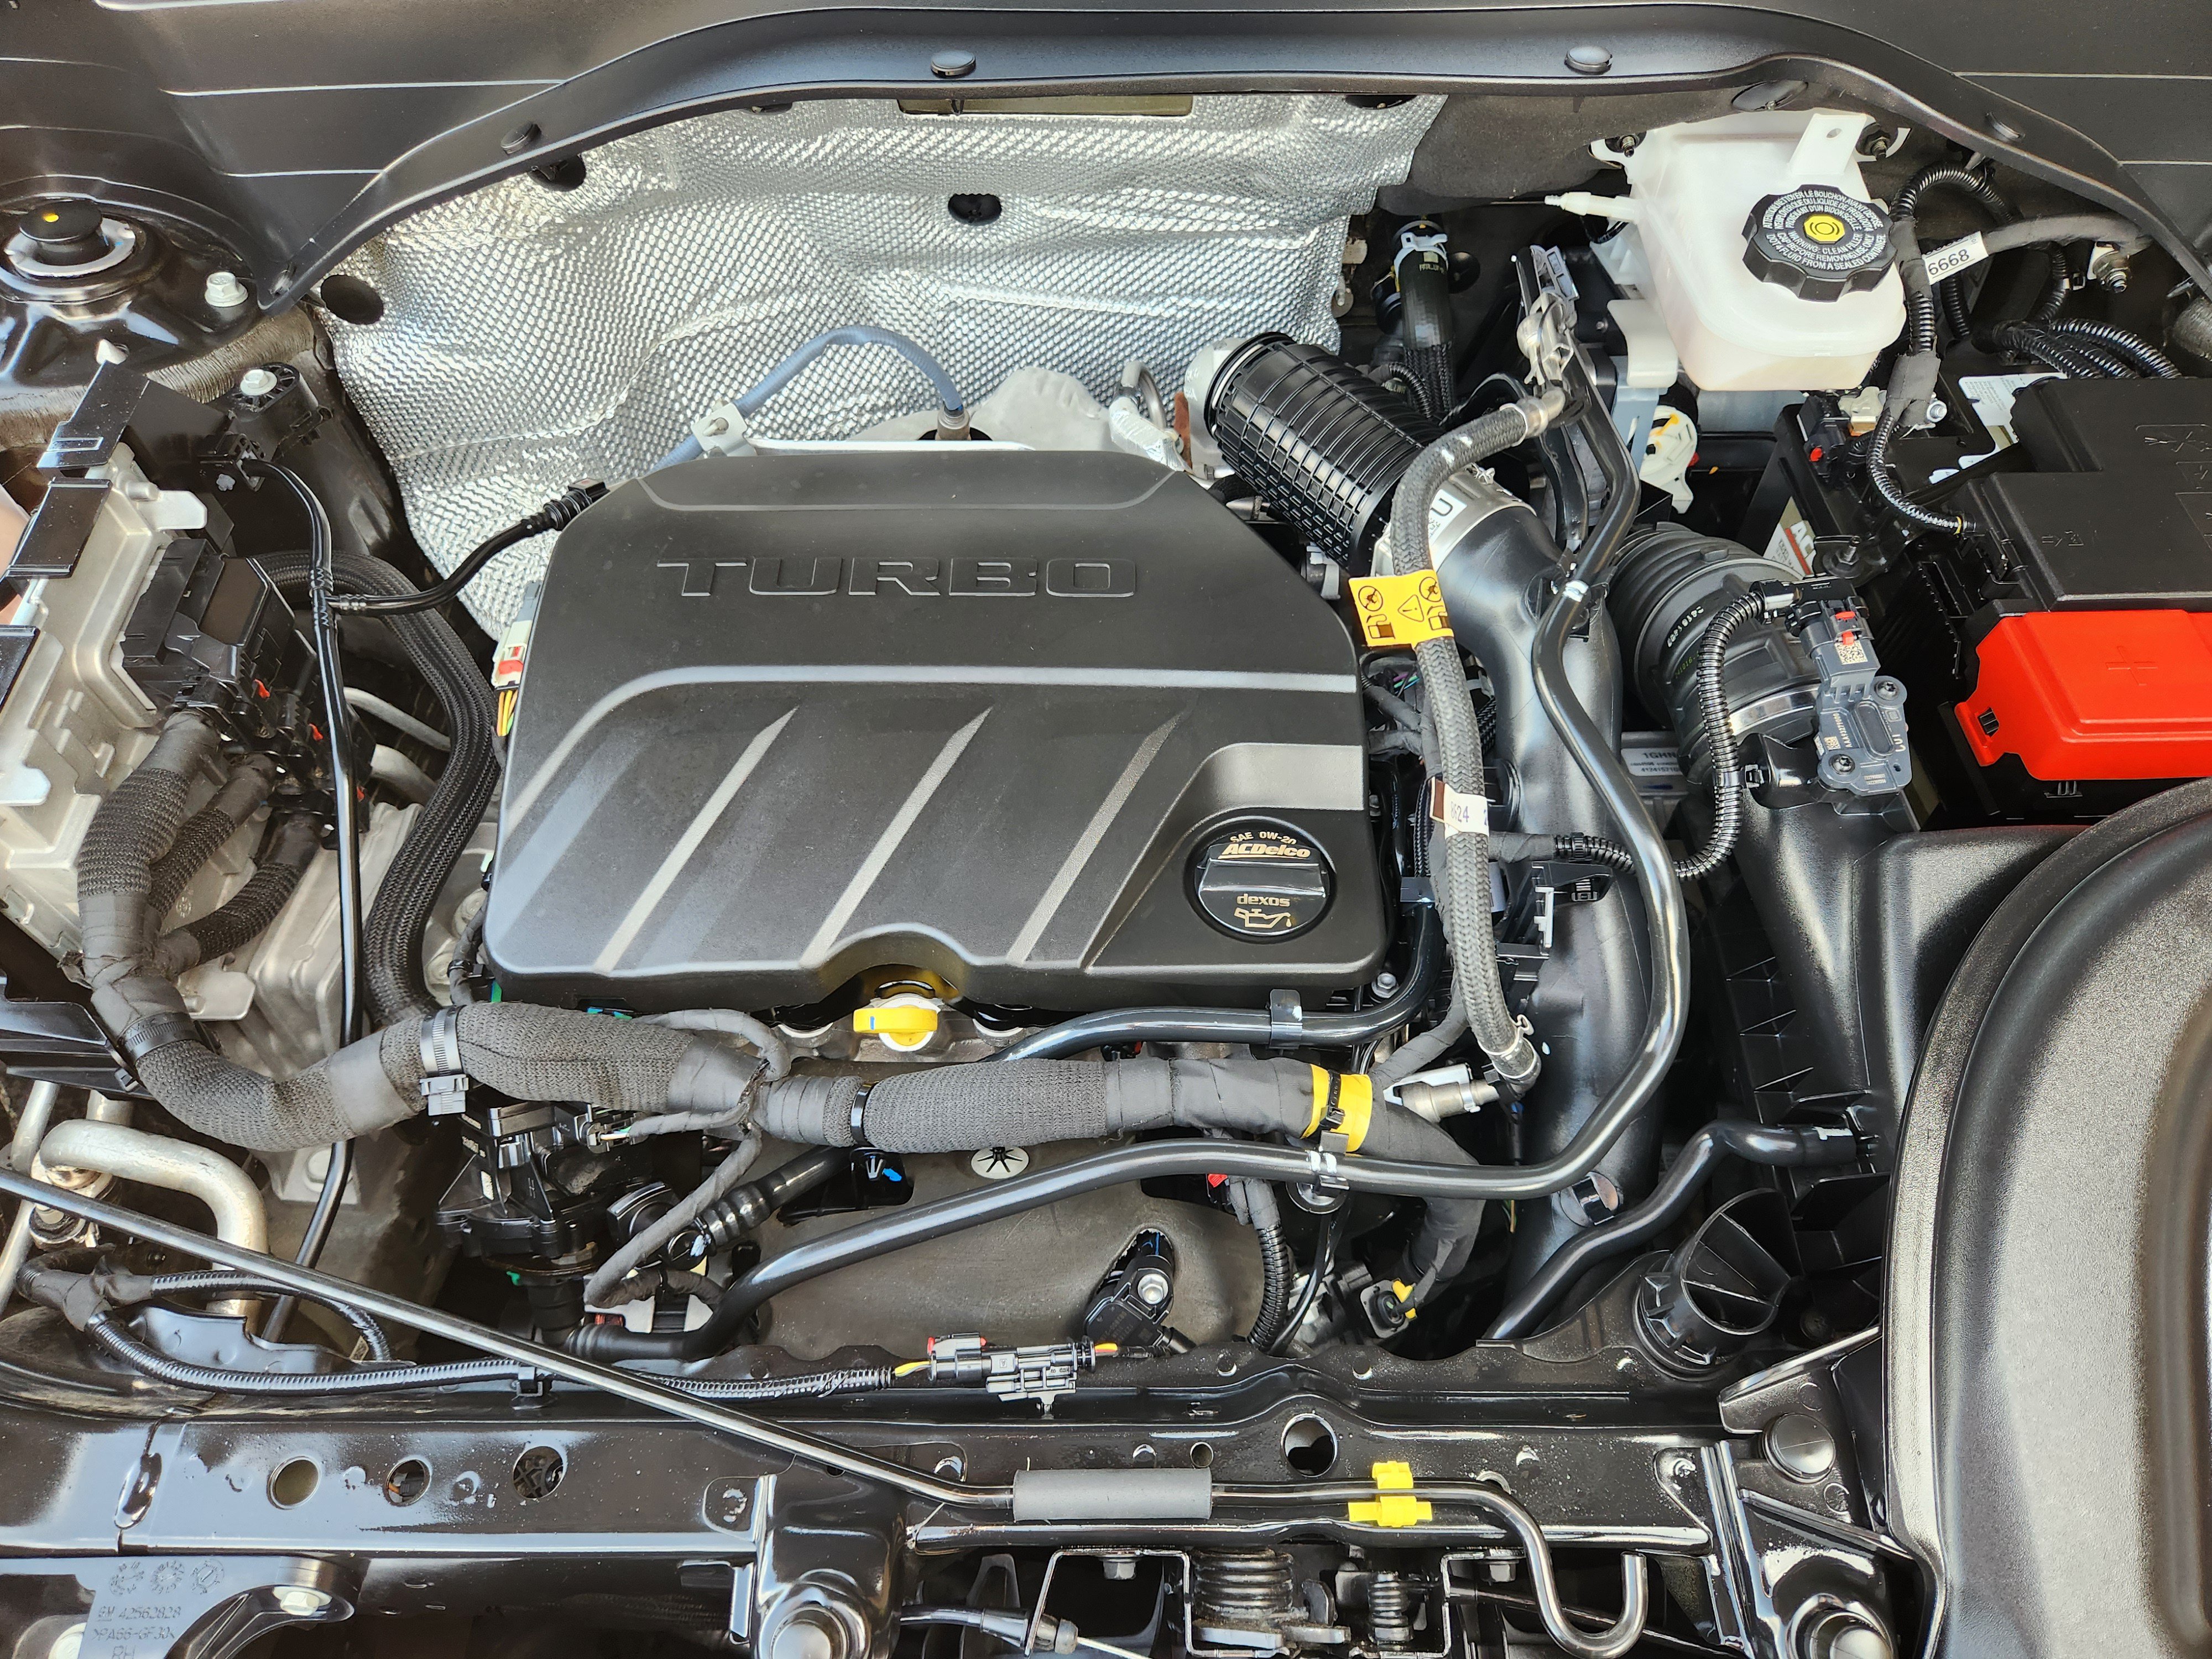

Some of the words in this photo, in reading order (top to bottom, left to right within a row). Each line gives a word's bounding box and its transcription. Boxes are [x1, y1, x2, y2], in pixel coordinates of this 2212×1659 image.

[1790, 200, 1804, 208] QUE
[1814, 198, 1839, 207] LIQUIDE
[1838, 202, 1849, 211] DE
[1846, 206, 1866, 221] FREIN
[1804, 190, 1814, 198] LE
[1814, 190, 1846, 202] BOUCHON
[1845, 199, 1868, 212] AVANT
[1785, 206, 1809, 228] PROVENANT
[1824, 205, 1845, 216] BIDON
[1842, 212, 1863, 231] SCELLE
[1777, 232, 1791, 244] CAP
[1786, 242, 1816, 259] BEFORE
[1862, 234, 1875, 248] ONLY
[1788, 231, 1820, 254] WARNING:
[1822, 245, 1849, 255] CLEAN
[1845, 233, 1863, 251] FILLER
[1779, 247, 1802, 263] FLUID
[1802, 258, 1826, 269] FROM
[1827, 262, 1834, 270] A
[1834, 259, 1865, 271] SEALED
[1928, 249, 1969, 275] 6668
[656, 557, 1137, 597] TURBO
[1230, 832, 1254, 842] SAE
[1259, 831, 1297, 845] 0W-20
[1221, 843, 1311, 858] ACDelco
[1237, 893, 1291, 907] dexos
[118, 1606, 181, 1620] 42562828
